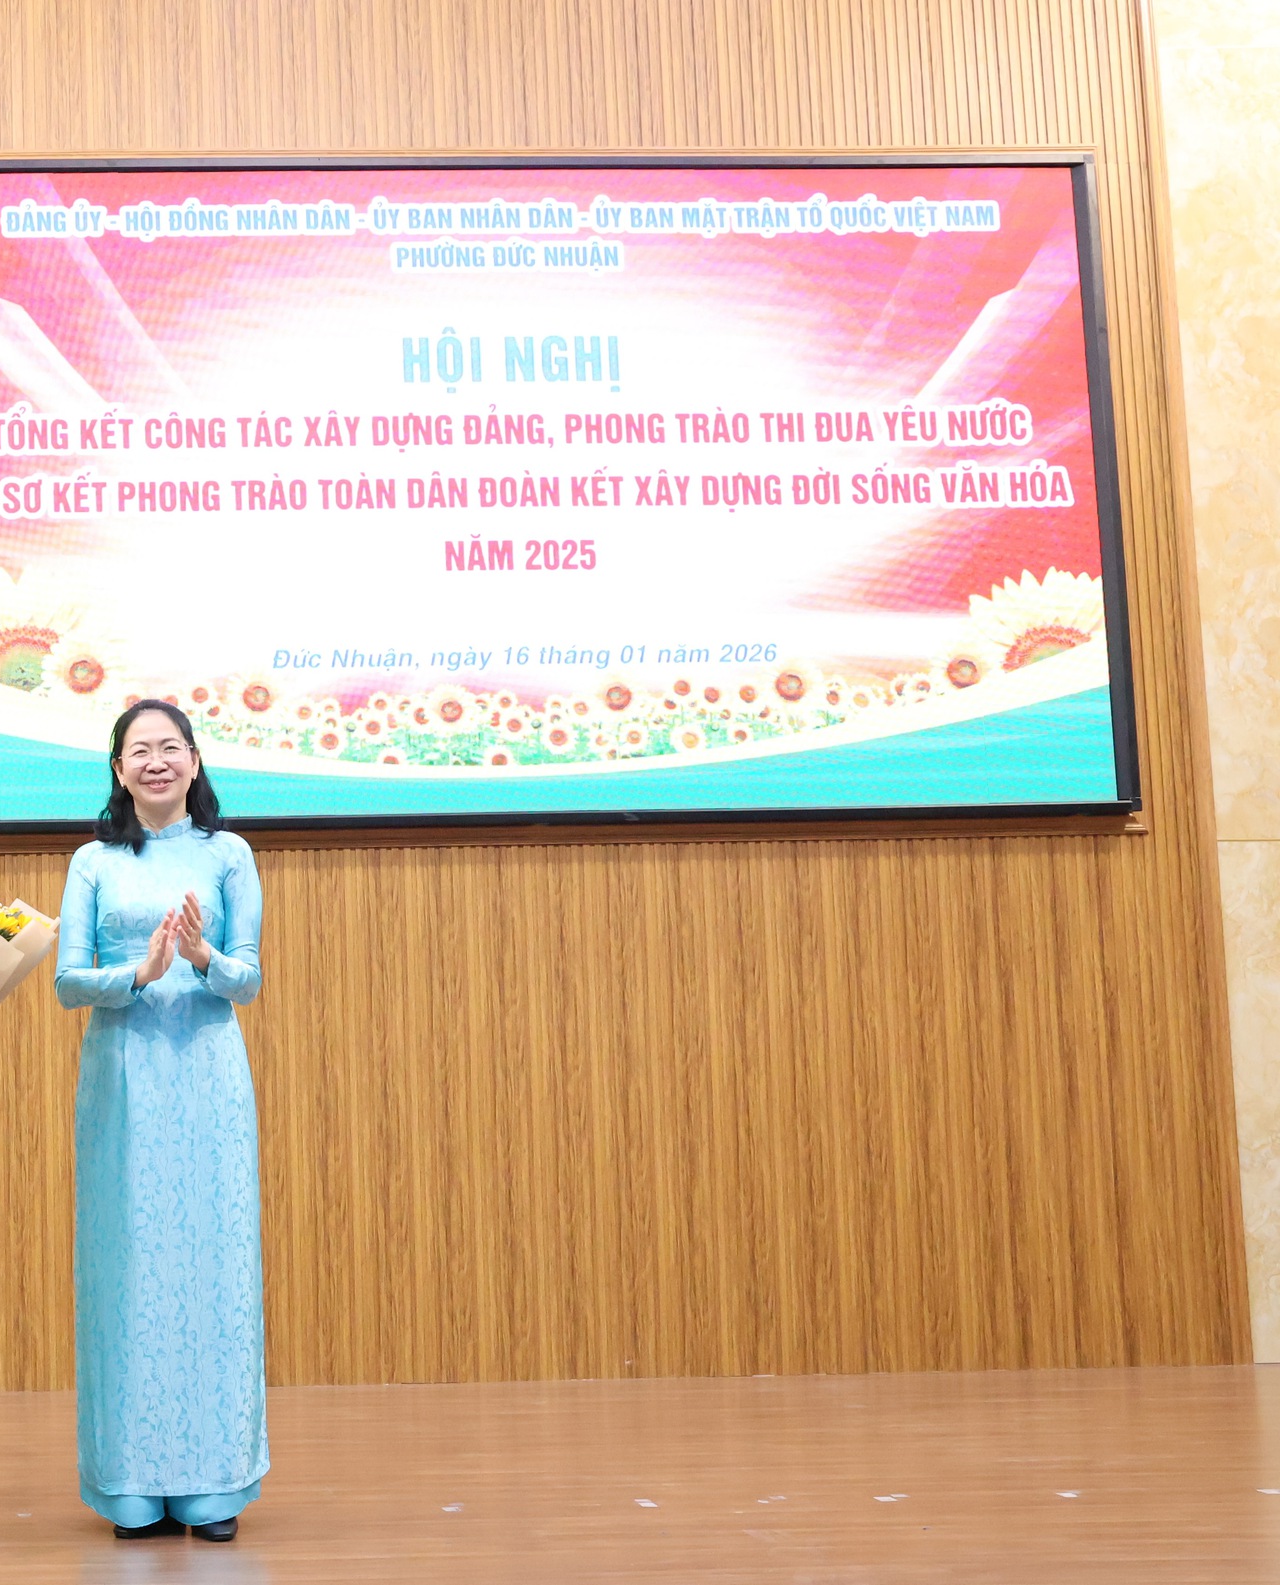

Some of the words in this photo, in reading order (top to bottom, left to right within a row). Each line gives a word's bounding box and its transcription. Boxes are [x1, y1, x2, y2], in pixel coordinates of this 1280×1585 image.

[6, 203, 66, 232] ĐẢNG
[75, 202, 101, 232] ỦY
[125, 206, 161, 237] HỘI
[169, 202, 229, 231] ĐỒNG
[237, 203, 297, 231] NHÂN
[306, 203, 350, 230] DÂN
[374, 201, 400, 229] ỦY
[408, 207, 452, 229] BAN
[461, 202, 520, 229] NHÂN
[529, 202, 573, 228] DÂN
[596, 200, 622, 228] ỦY
[630, 206, 674, 228] BAN
[682, 202, 727, 235] MẶT
[734, 202, 790, 235] TRẬN
[797, 197, 827, 227] TỔ
[831, 197, 886, 231] QUỐC
[894, 201, 937, 234] VIỆT
[946, 205, 995, 226] NAM
[397, 240, 484, 268] PHƯỜNG
[492, 242, 536, 267] ĐỨC
[544, 241, 619, 271] NHUẬN
[403, 327, 482, 393] HỘI
[504, 335, 620, 392] NGHỊ
[80, 409, 133, 449] KẾT
[145, 412, 226, 449] CÔNG
[236, 411, 292, 447] TÁC
[304, 410, 360, 447] XÂY
[372, 413, 453, 453] DỰNG
[463, 403, 554, 448] ĐẢNG,
[565, 413, 666, 445] PHONG
[675, 407, 749, 443] TRÀO
[759, 413, 804, 442] THI
[815, 412, 874, 442] ĐUA
[883, 405, 936, 441] YÊU
[948, 403, 1027, 441] NƯỚC
[3, 479, 43, 513] SƠ
[53, 472, 107, 512] KẾT
[118, 480, 220, 512] PHONG
[231, 473, 307, 511] TRÀO
[318, 472, 396, 510] TOÀN
[407, 471, 468, 508] DÂN
[478, 470, 560, 507] ĐOÀN
[570, 466, 624, 507] KẾT
[634, 469, 690, 506] XÂY
[701, 472, 782, 512] DỰNG
[791, 467, 841, 505] ĐỜI
[851, 463, 931, 503] SỐNG
[940, 465, 1000, 503] VĂN
[1009, 465, 1068, 502] HÓA
[444, 533, 514, 571] NĂM
[525, 539, 597, 570] 2025
[272, 648, 321, 669] Đức
[331, 648, 419, 671] Nhuận,
[430, 646, 492, 671] ngày
[504, 646, 530, 665] 16
[539, 645, 610, 669] tháng
[620, 645, 646, 664] 01
[657, 644, 710, 663] năm
[719, 643, 777, 662] 2026
